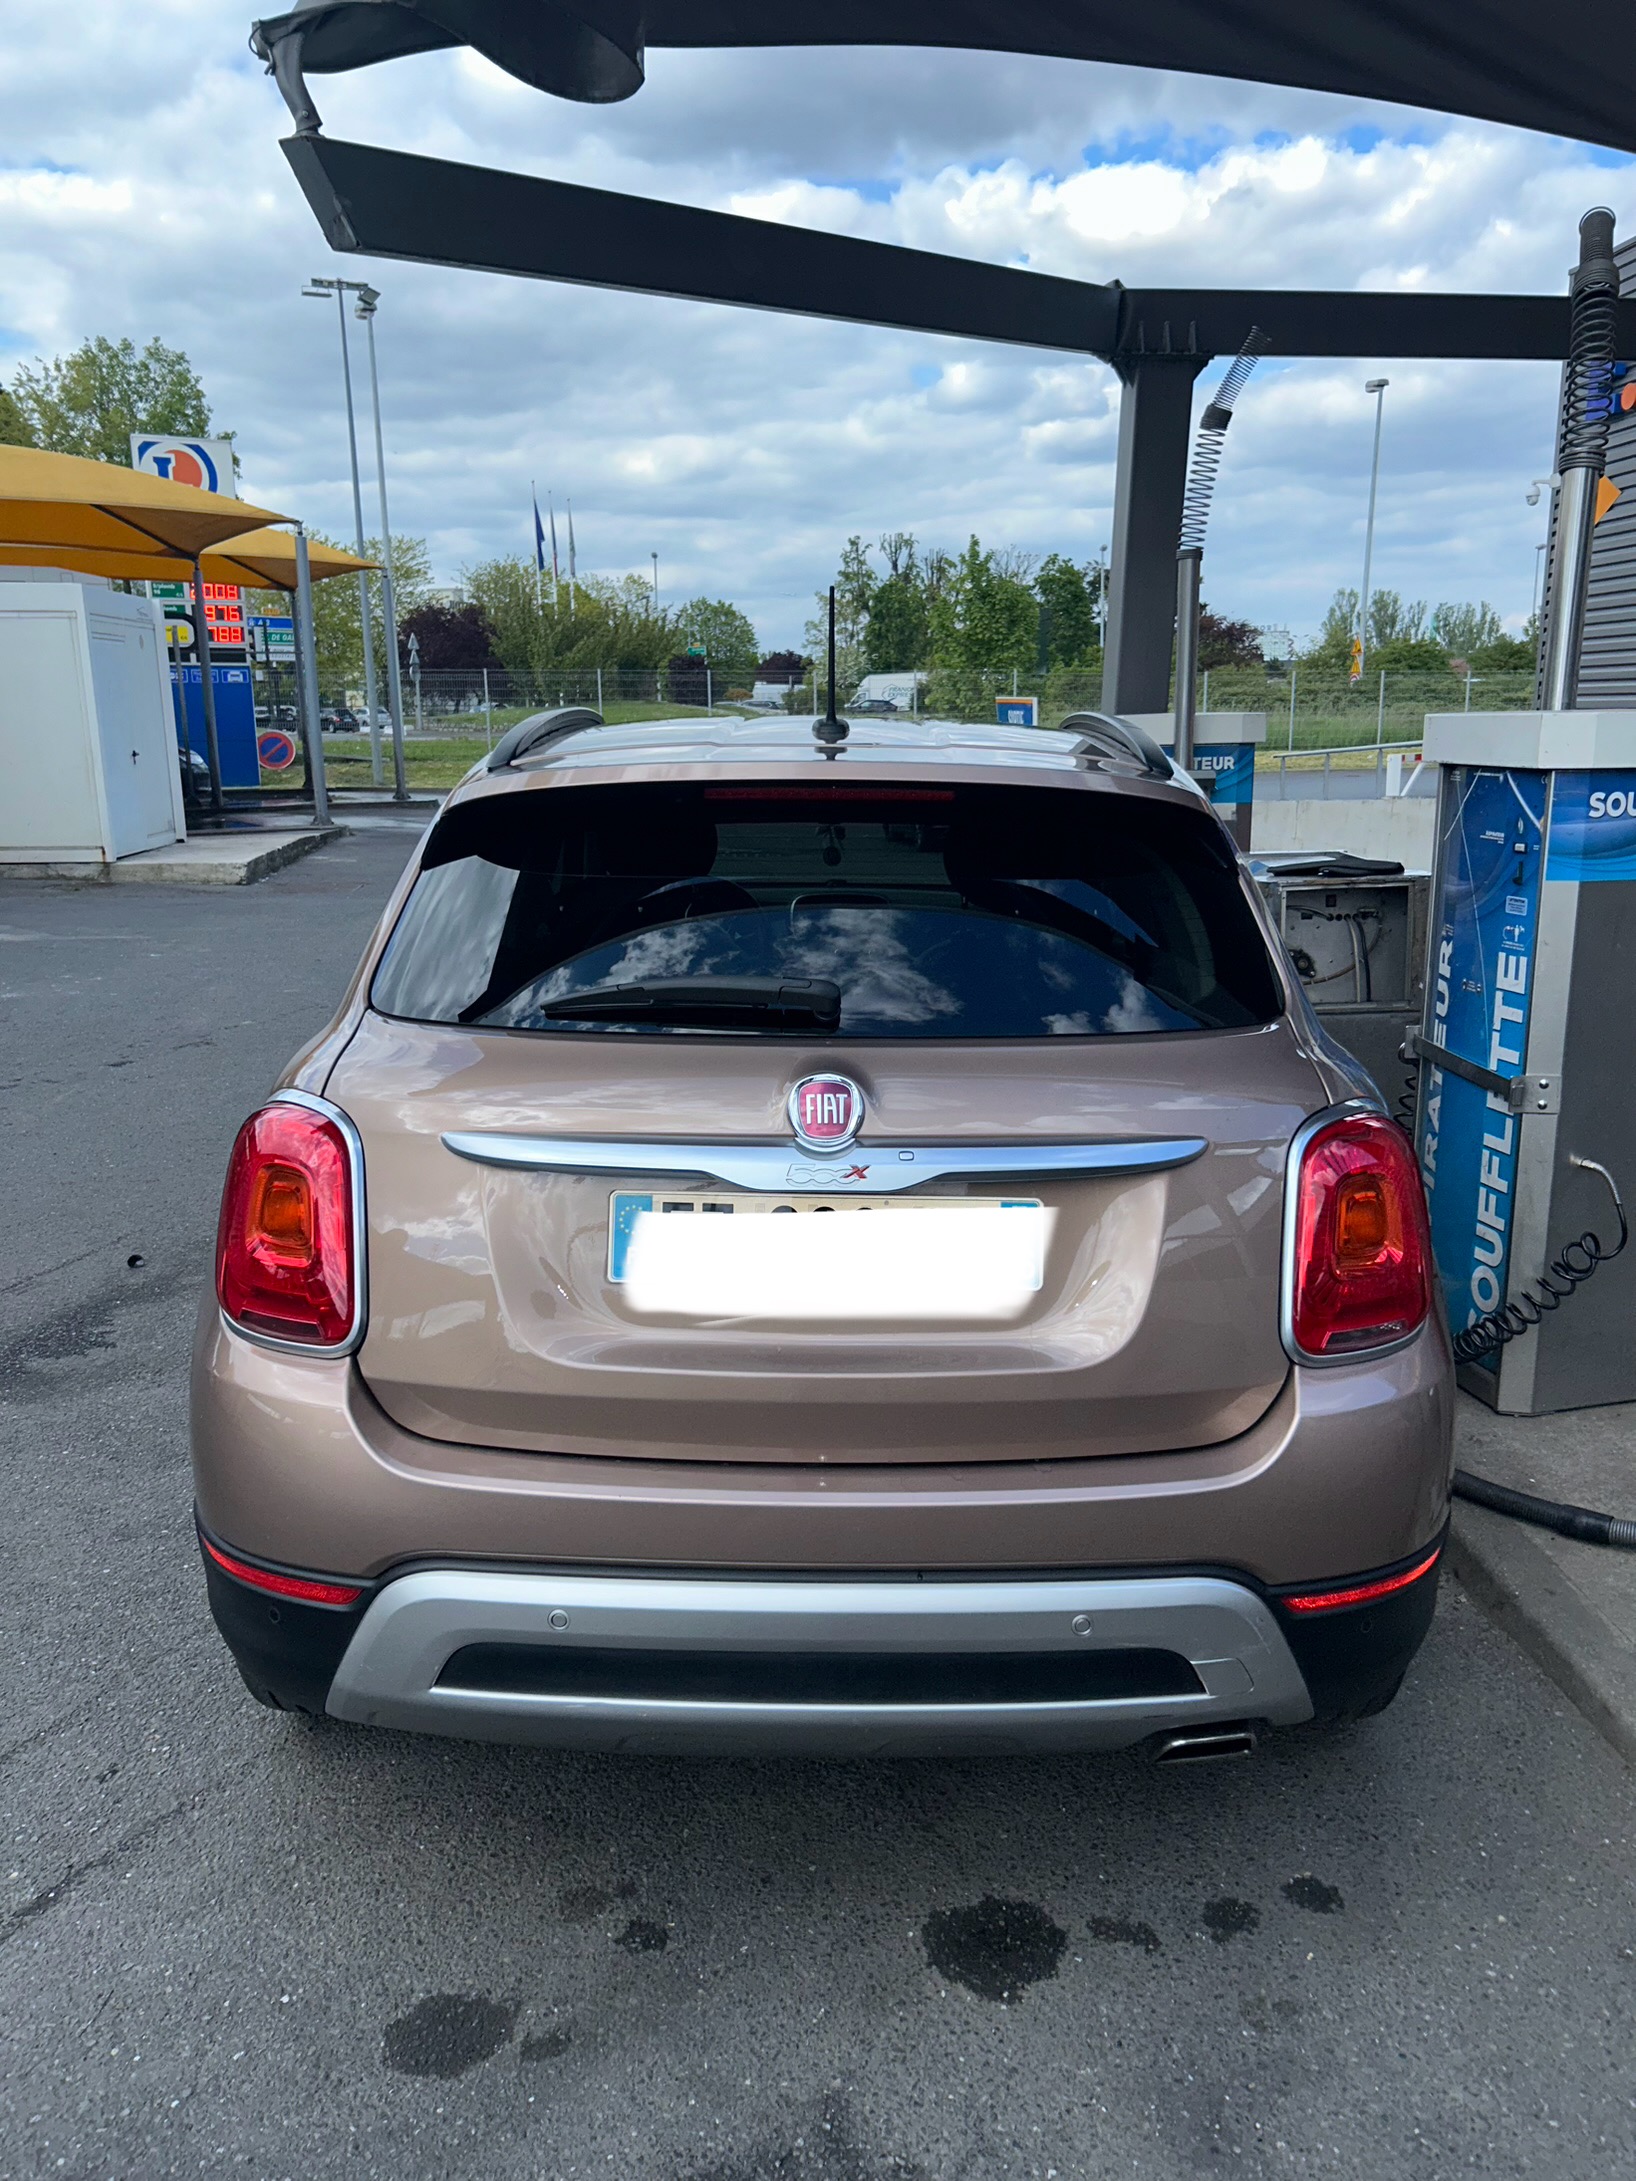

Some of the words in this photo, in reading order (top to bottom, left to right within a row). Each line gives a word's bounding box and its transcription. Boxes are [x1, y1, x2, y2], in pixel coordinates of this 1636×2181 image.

[204, 604, 240, 622] 976
[207, 626, 242, 643] 788
[1193, 756, 1235, 770] TEUR
[1423, 940, 1453, 1226] IRATEUR
[805, 1093, 848, 1124] FIAT
